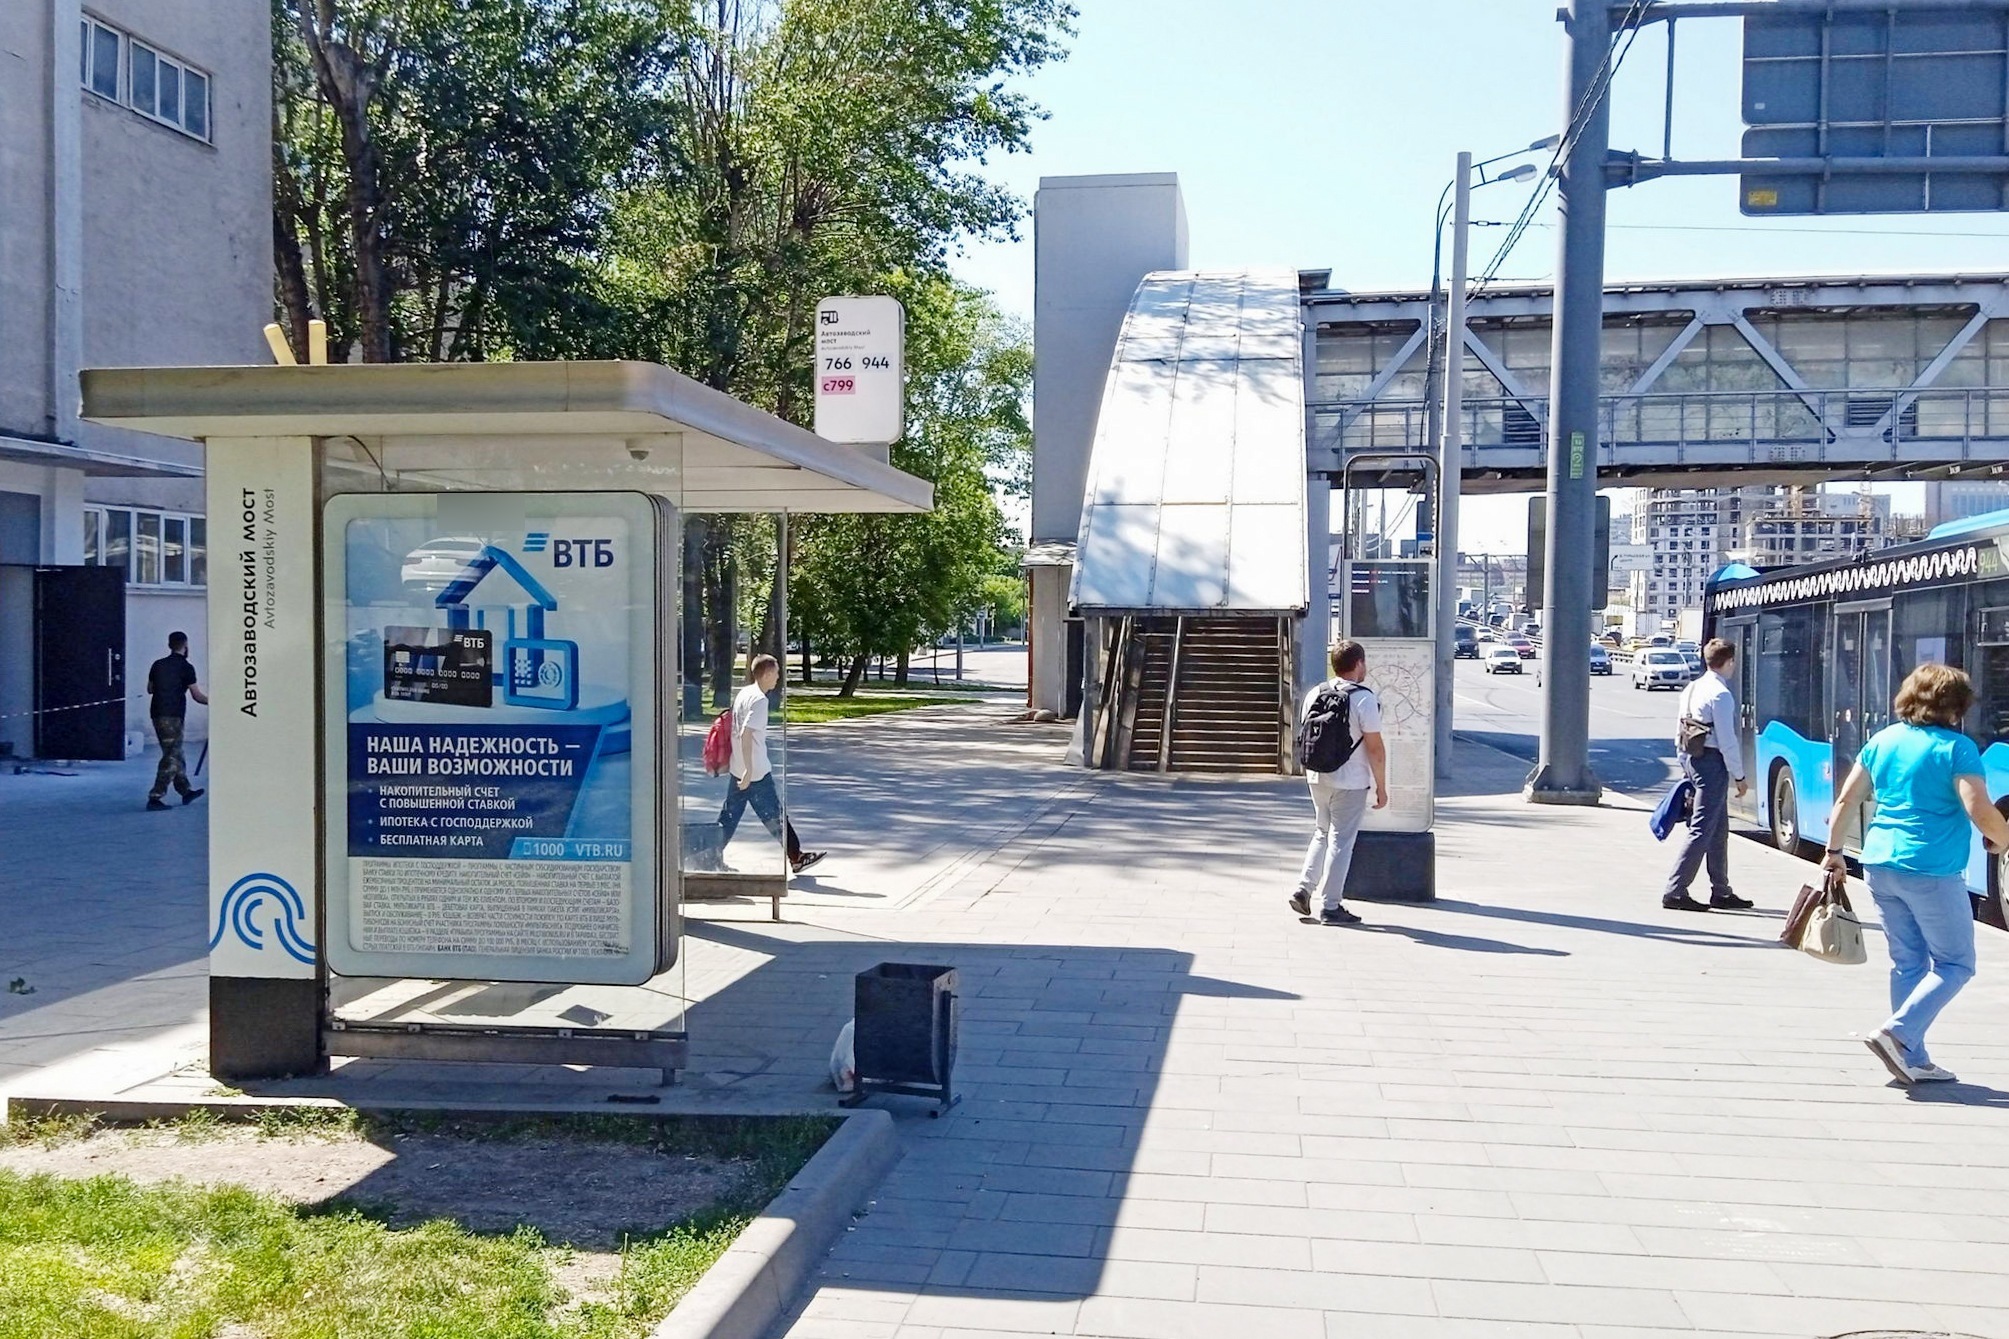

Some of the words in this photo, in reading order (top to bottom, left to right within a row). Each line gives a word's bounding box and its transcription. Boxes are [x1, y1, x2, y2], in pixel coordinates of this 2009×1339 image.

[825, 356, 852, 370] 766
[862, 356, 889, 369] 944
[242, 487, 255, 541] мост
[263, 488, 275, 524] Most
[553, 539, 614, 568] ВТБ
[1979, 551, 1999, 574] 944
[262, 529, 277, 629] Avtozavodskiy
[239, 551, 258, 718] Автозаводский
[463, 637, 485, 649] ВТБ
[367, 736, 424, 753] НАША
[429, 737, 559, 757] НАДЕЖНОСТЬ
[367, 757, 422, 775] ВАШИ
[427, 758, 573, 776] ВОЗМОЖНОСТИ
[380, 784, 472, 798] НАКОПИТЕЛЬНЫЙ
[474, 786, 500, 798] СЧЕТ
[380, 798, 387, 809] С
[389, 797, 465, 809] ПОВЫШЕННОЙ
[467, 797, 516, 810] СТАВКОЙ
[380, 816, 429, 827] ИПОТЕКА
[430, 817, 438, 828] С
[440, 816, 534, 830] ГОСПОДДЕРЖКОЙ
[380, 834, 447, 846] БЕСПЛАТНАЯ
[449, 835, 484, 847] КАРТА
[533, 842, 565, 856] 1000
[575, 843, 623, 857] VTB.RU
